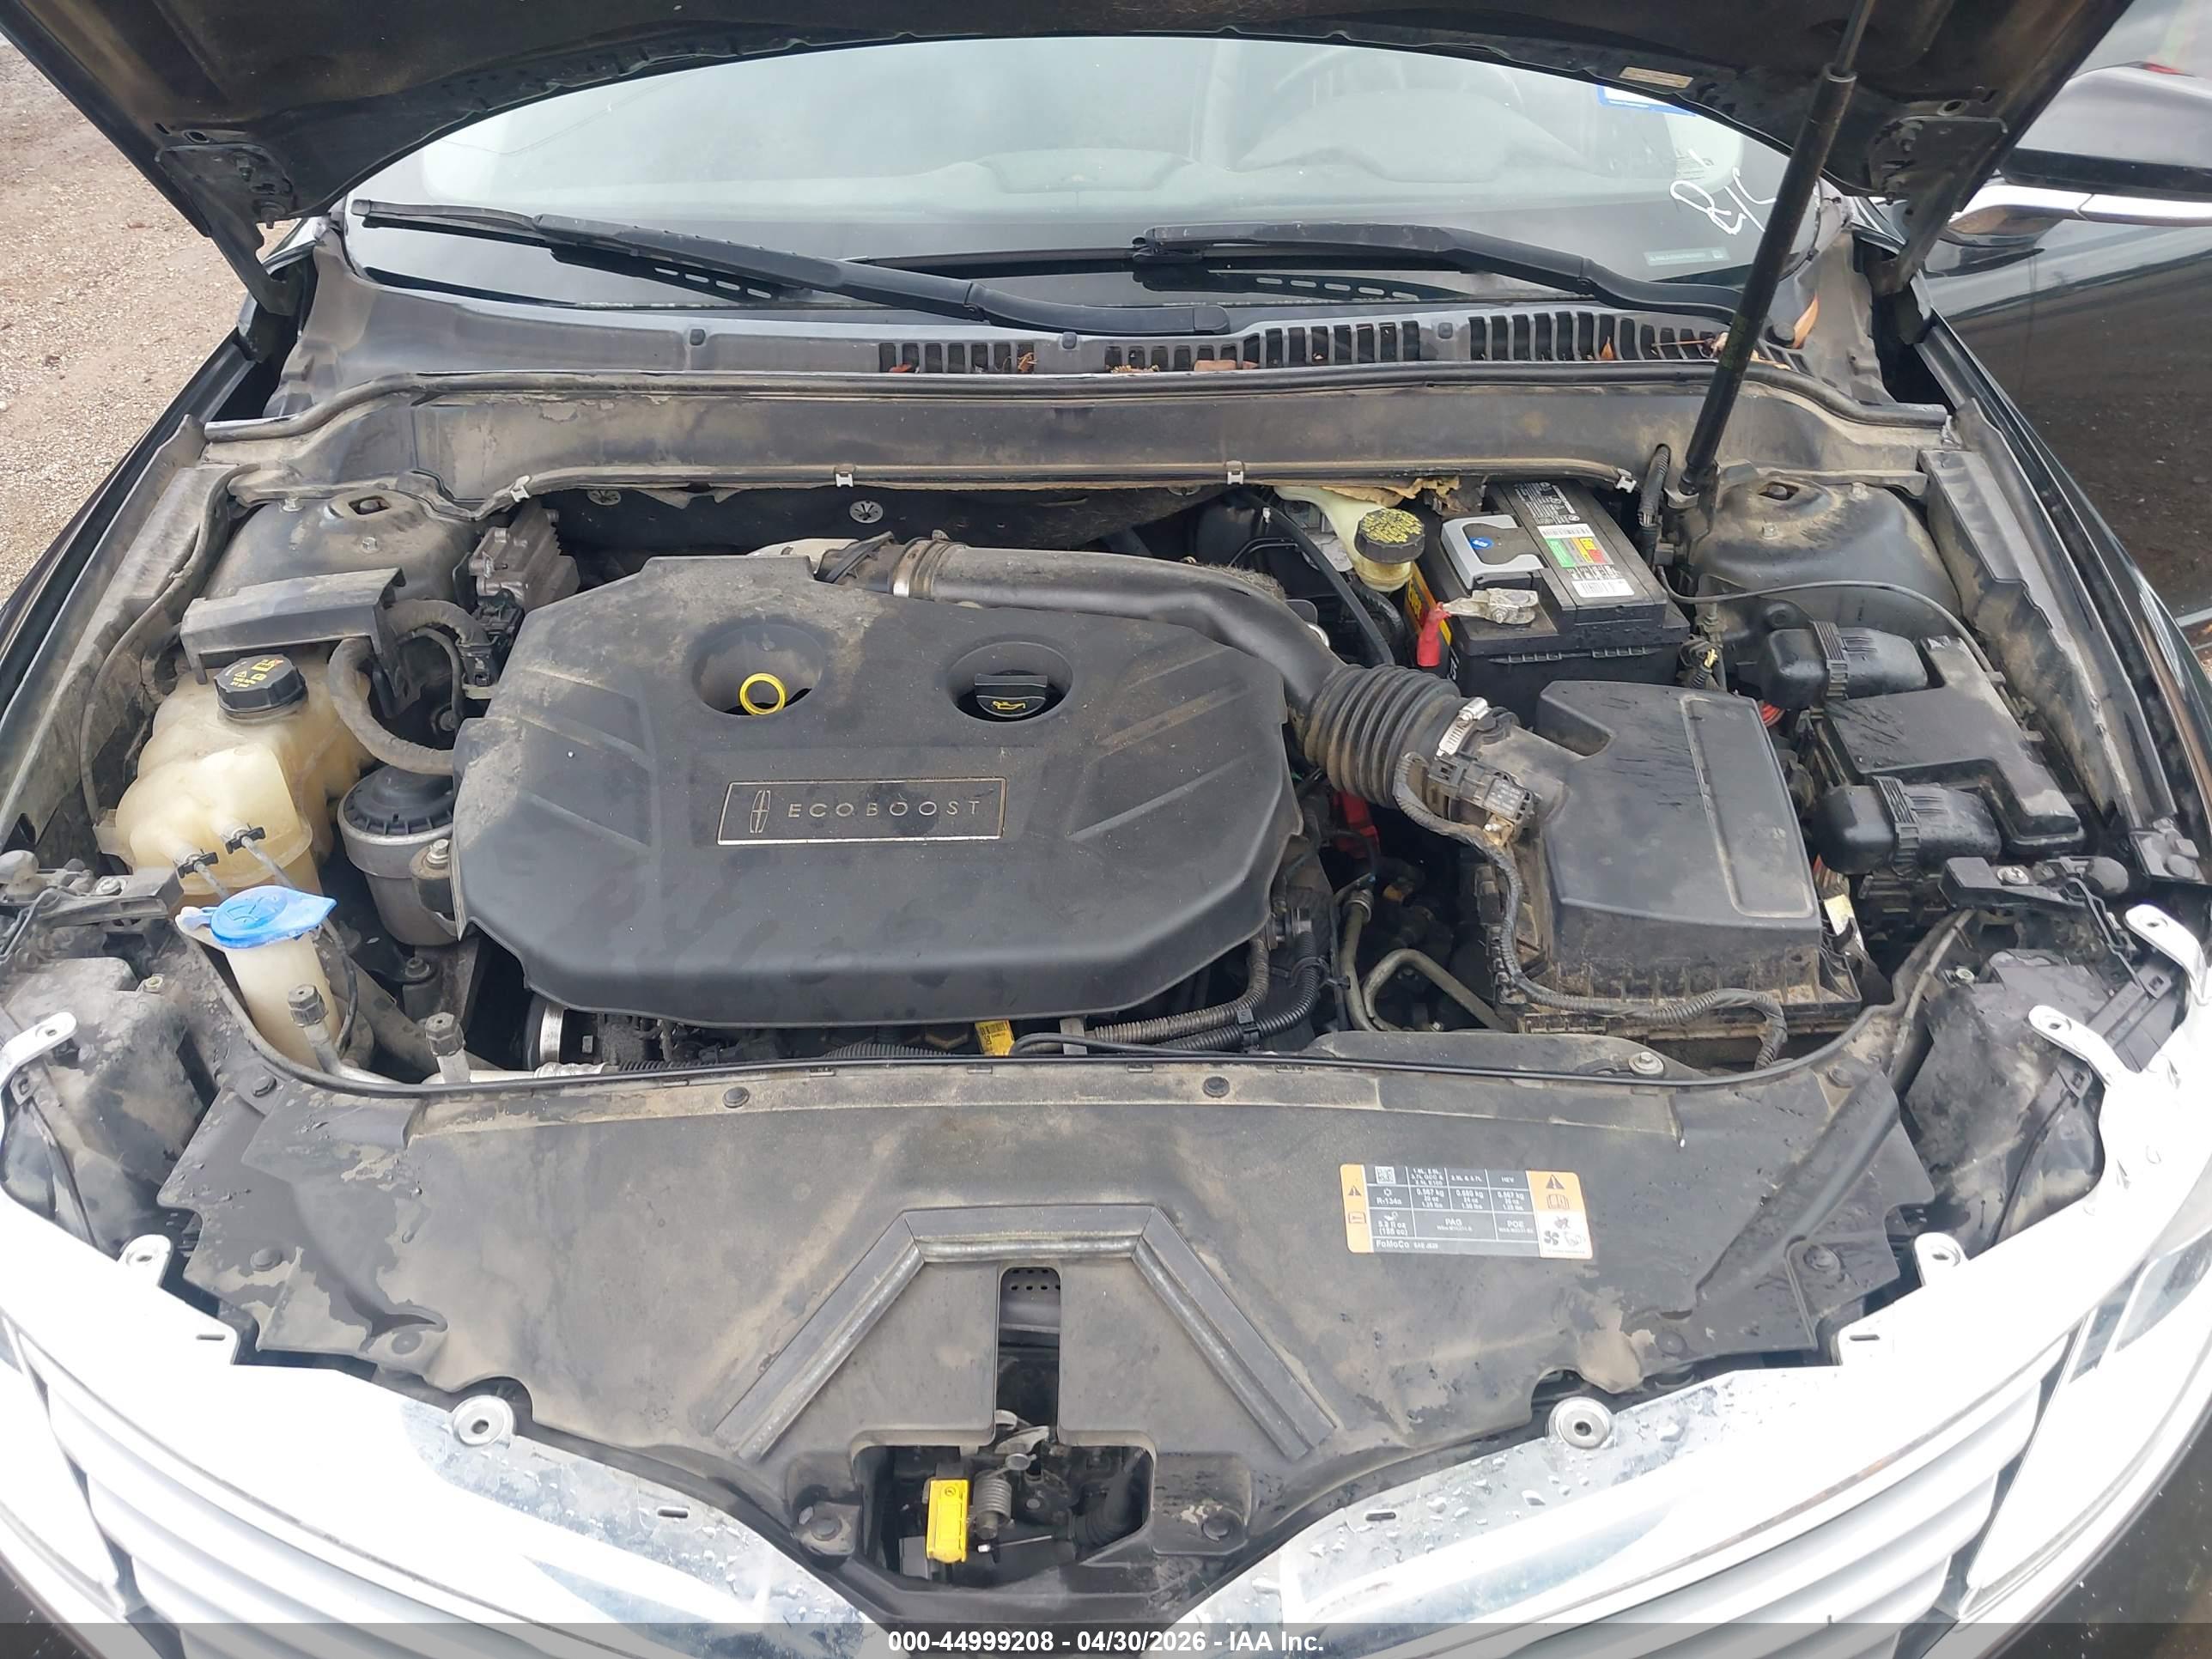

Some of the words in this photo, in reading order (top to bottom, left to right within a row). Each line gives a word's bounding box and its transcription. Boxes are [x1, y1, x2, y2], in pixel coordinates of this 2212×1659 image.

[788, 799, 980, 818] ECOBOOST
[1435, 1188, 1444, 1198] kg
[1474, 1190, 1484, 1199] kg
[1445, 1218, 1463, 1226] PAG
[1506, 1219, 1525, 1228] POE
[1376, 1239, 1410, 1249] FoMoCo
